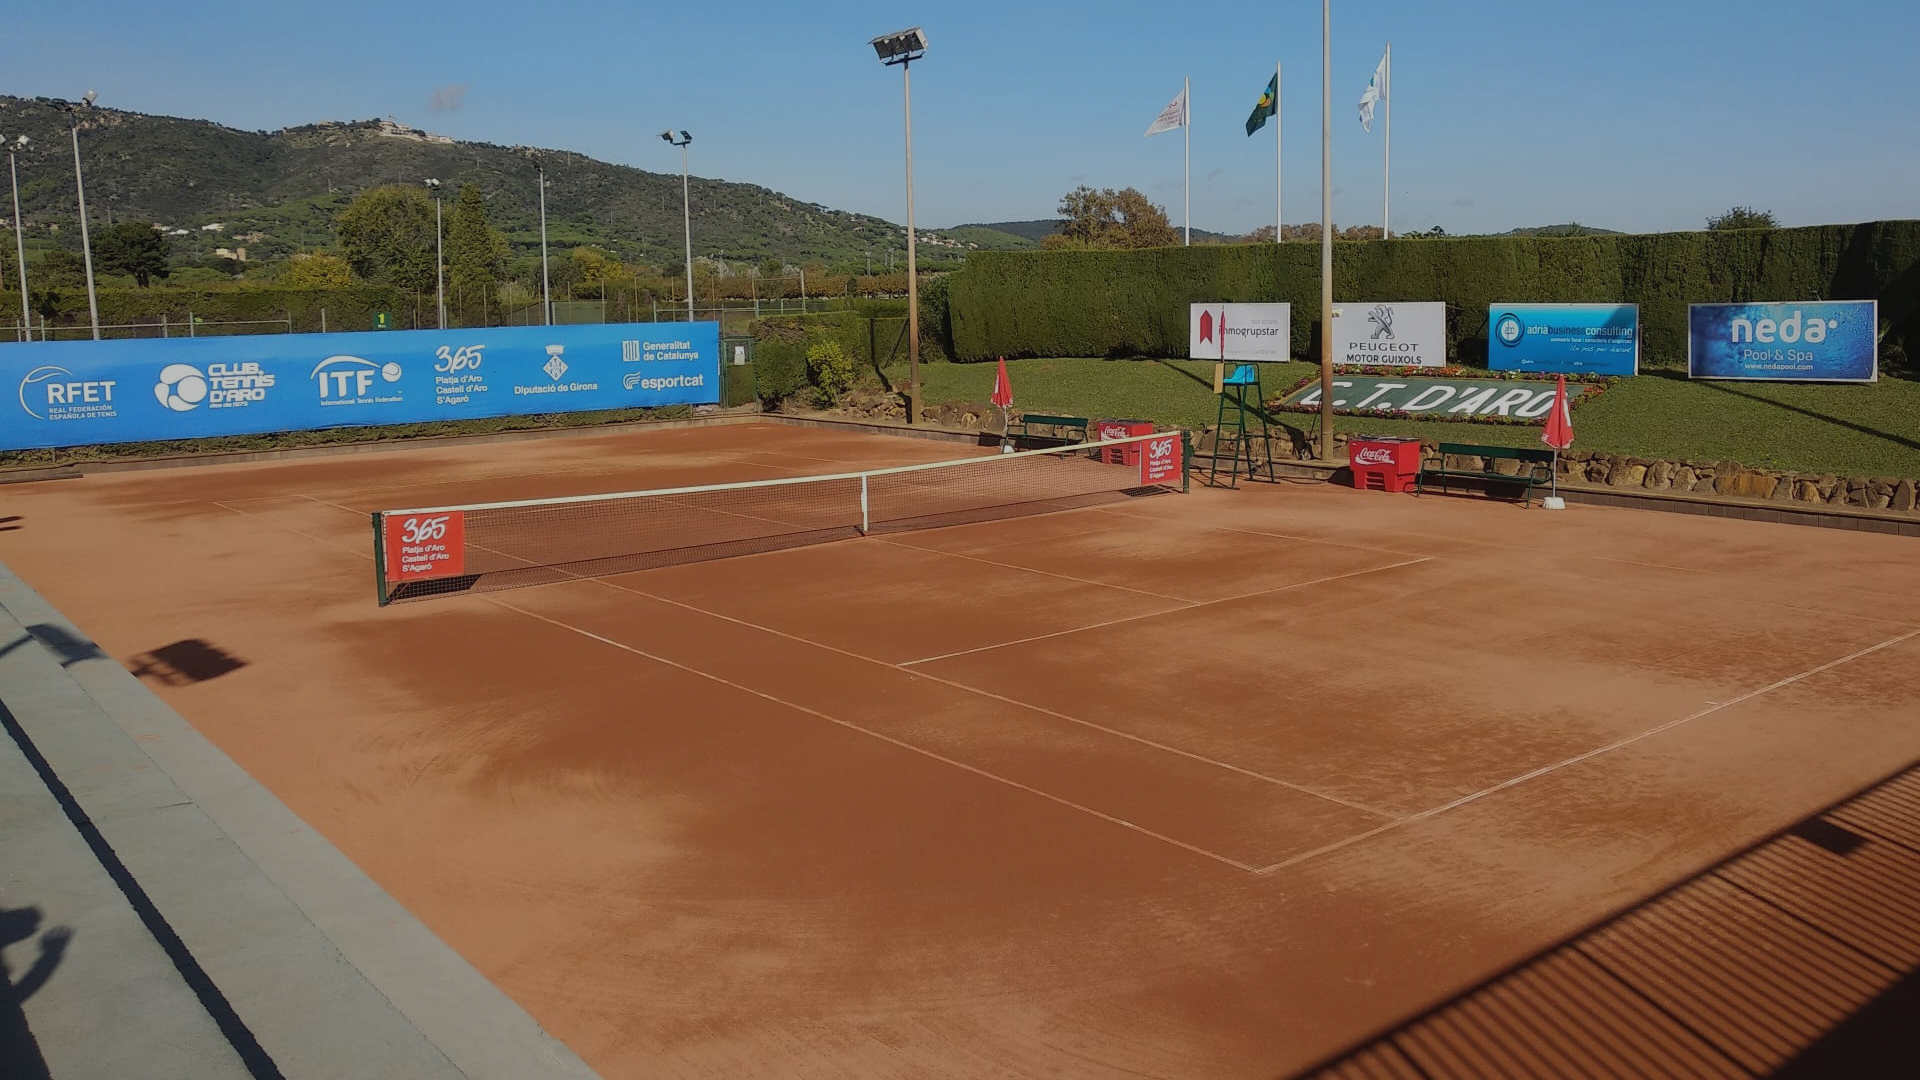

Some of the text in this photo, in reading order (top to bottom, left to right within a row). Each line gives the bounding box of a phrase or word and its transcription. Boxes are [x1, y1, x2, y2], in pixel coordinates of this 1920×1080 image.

[378, 313, 384, 324] 1
[643, 341, 691, 351] Generalitat
[1349, 342, 1419, 352] PEUGEOT
[434, 344, 486, 374] 365
[643, 352, 699, 361] de Catalunya
[1346, 354, 1422, 364] MOTOR GUIXOLS
[1744, 349, 1813, 362] Pool & Spa
[1744, 363, 1814, 371] www.nedapool.com
[319, 370, 375, 398] ITF
[435, 375, 483, 384] Platja d'Aro
[641, 374, 704, 392] esportcat
[47, 380, 116, 404] RFET
[436, 384, 488, 395] Castell d'Aro
[514, 382, 598, 396] Diputació de Girona
[209, 388, 266, 403] D'ARO
[436, 395, 469, 405] S'Agaró
[68, 404, 113, 413] FEDERACIÓN
[49, 412, 86, 420] ESPAÑOLA
[97, 410, 118, 418] TENIS
[1149, 439, 1174, 459] 365
[402, 516, 450, 544] 365
[402, 544, 445, 554] Platja d'Aro
[402, 554, 428, 563] Castell
[402, 563, 432, 572] S'Agaró
